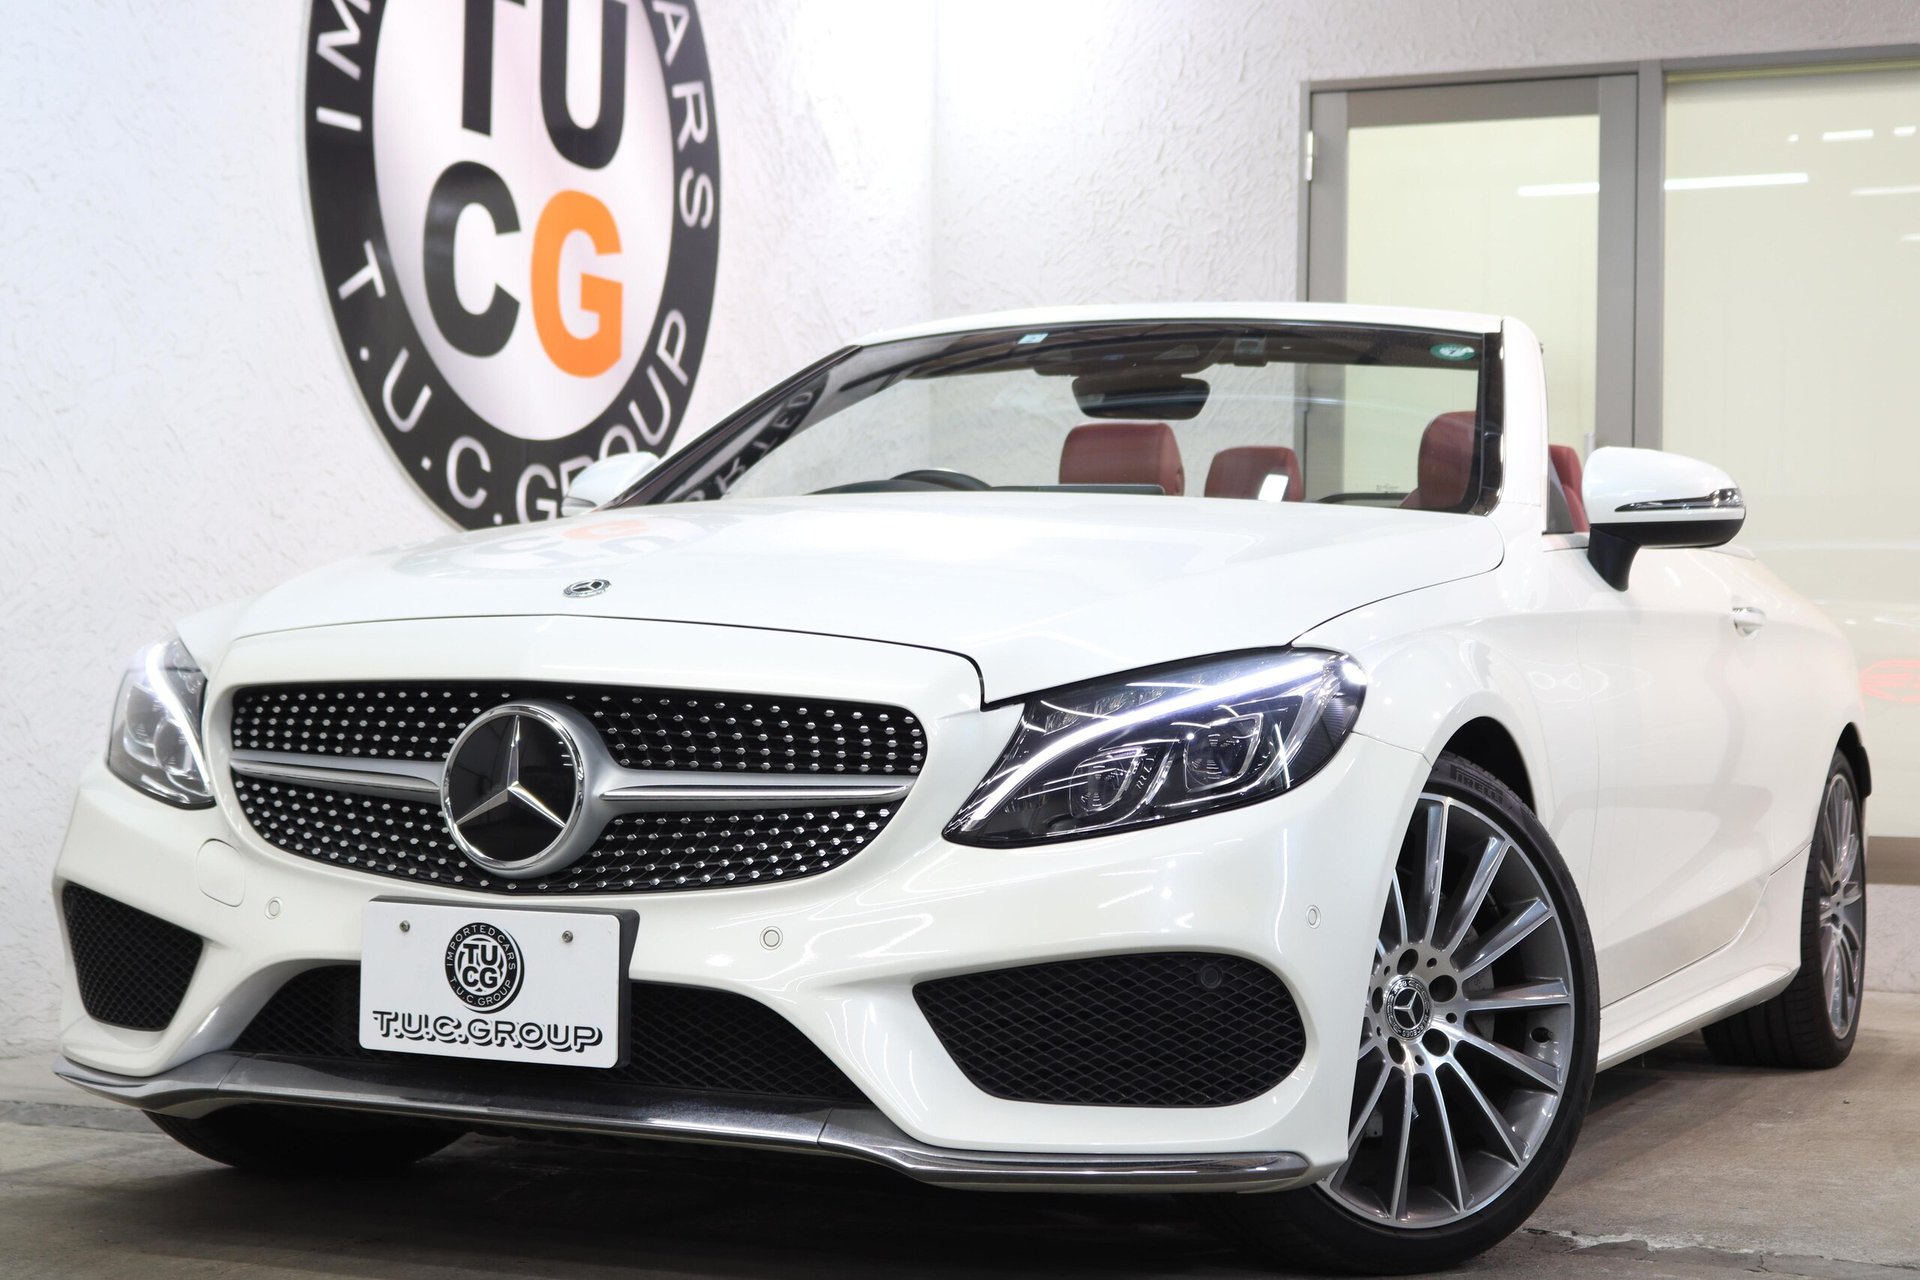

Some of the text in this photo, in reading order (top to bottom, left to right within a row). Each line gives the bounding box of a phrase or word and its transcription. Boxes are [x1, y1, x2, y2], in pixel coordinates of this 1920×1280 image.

[461, 0, 628, 171] TU
[423, 160, 623, 379] CG
[446, 924, 516, 971] IMPORTED CARS
[462, 943, 499, 967] TU
[450, 975, 512, 1006] T.U.C.GROUP
[462, 965, 499, 989] CG
[372, 1009, 604, 1053] T.U.C.GROUP
